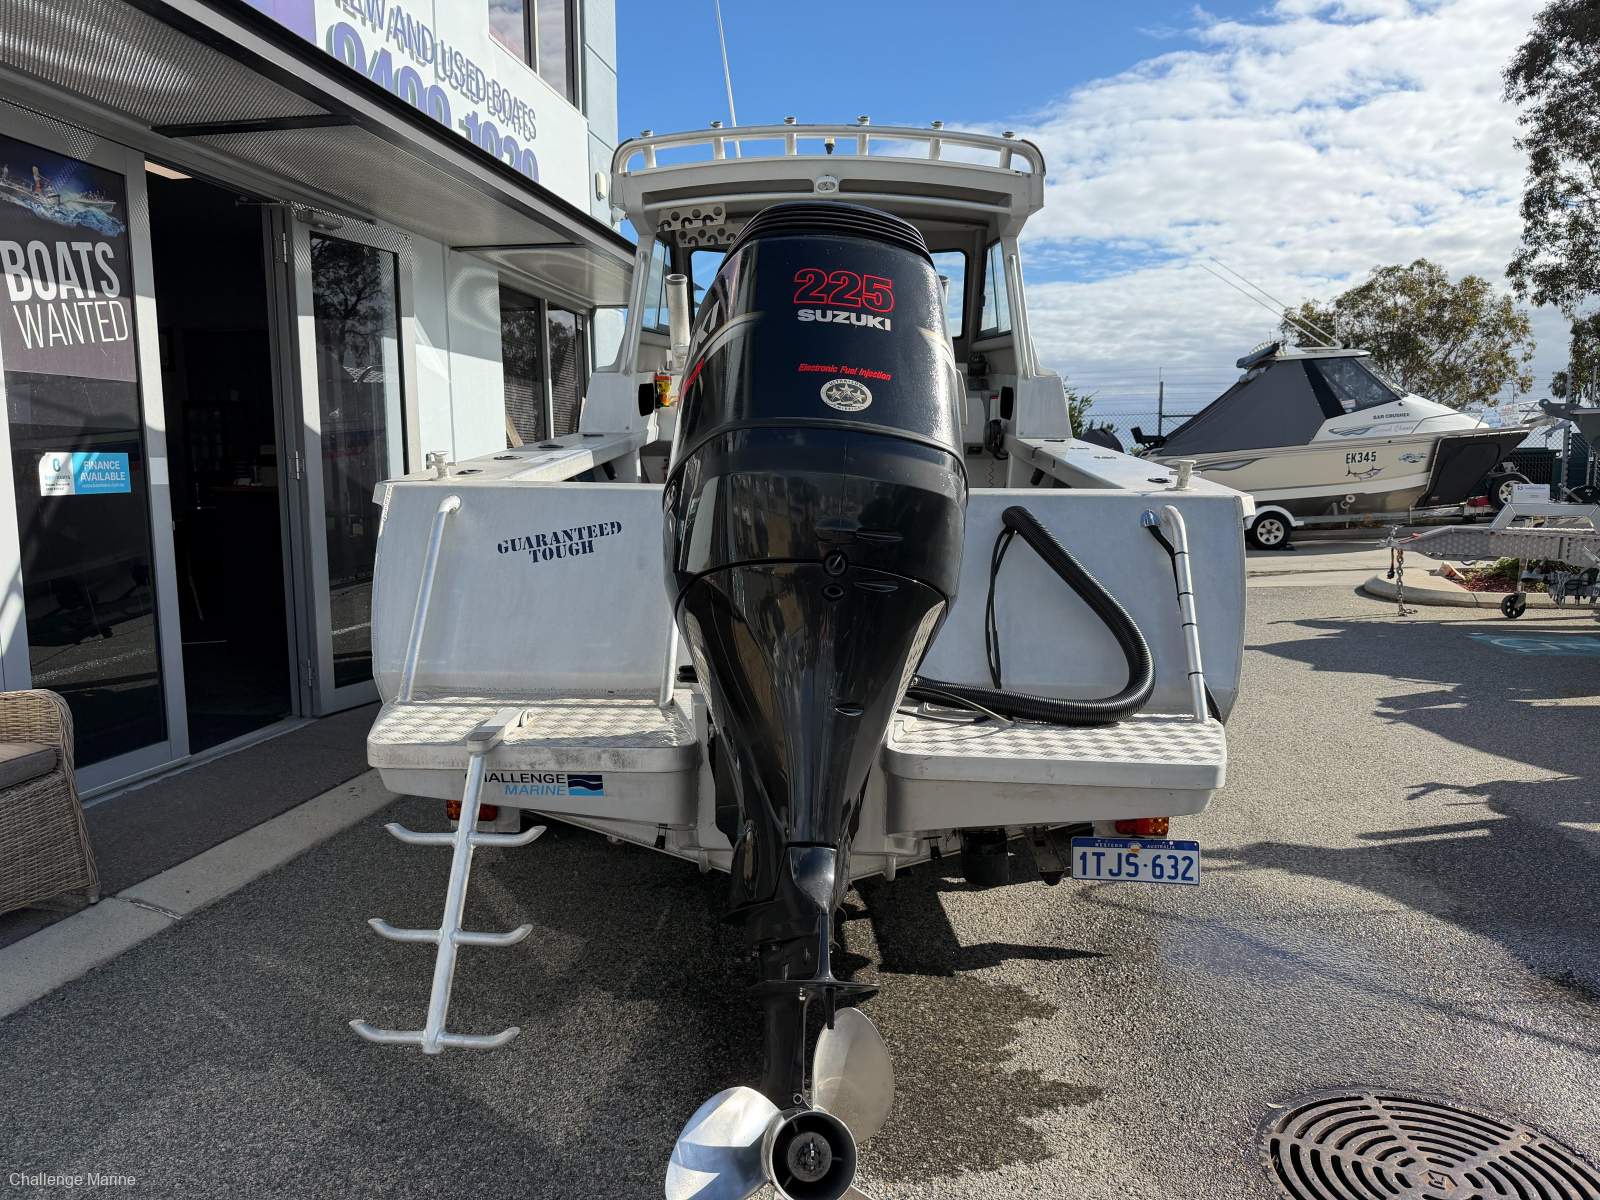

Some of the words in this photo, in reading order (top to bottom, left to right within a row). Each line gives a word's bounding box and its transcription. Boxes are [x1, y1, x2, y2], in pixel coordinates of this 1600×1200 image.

[391, 5, 435, 65] AND
[440, 39, 487, 103] USED
[490, 79, 537, 141] BOATS
[0, 240, 121, 302] BOATS
[793, 268, 895, 313] 225
[13, 300, 129, 350] WANTED
[797, 308, 892, 332] SUZUKI
[799, 363, 838, 373] Electronic
[840, 365, 858, 376] Fuel
[859, 367, 892, 381] Injection
[83, 460, 121, 470] FINANCE
[1345, 451, 1377, 464] EK345
[80, 471, 126, 481] AVAILABLE
[497, 520, 622, 554] GUARANTEED
[528, 539, 595, 563] TOUGH
[465, 772, 566, 784] ALLENGE
[504, 784, 567, 796] MARINE
